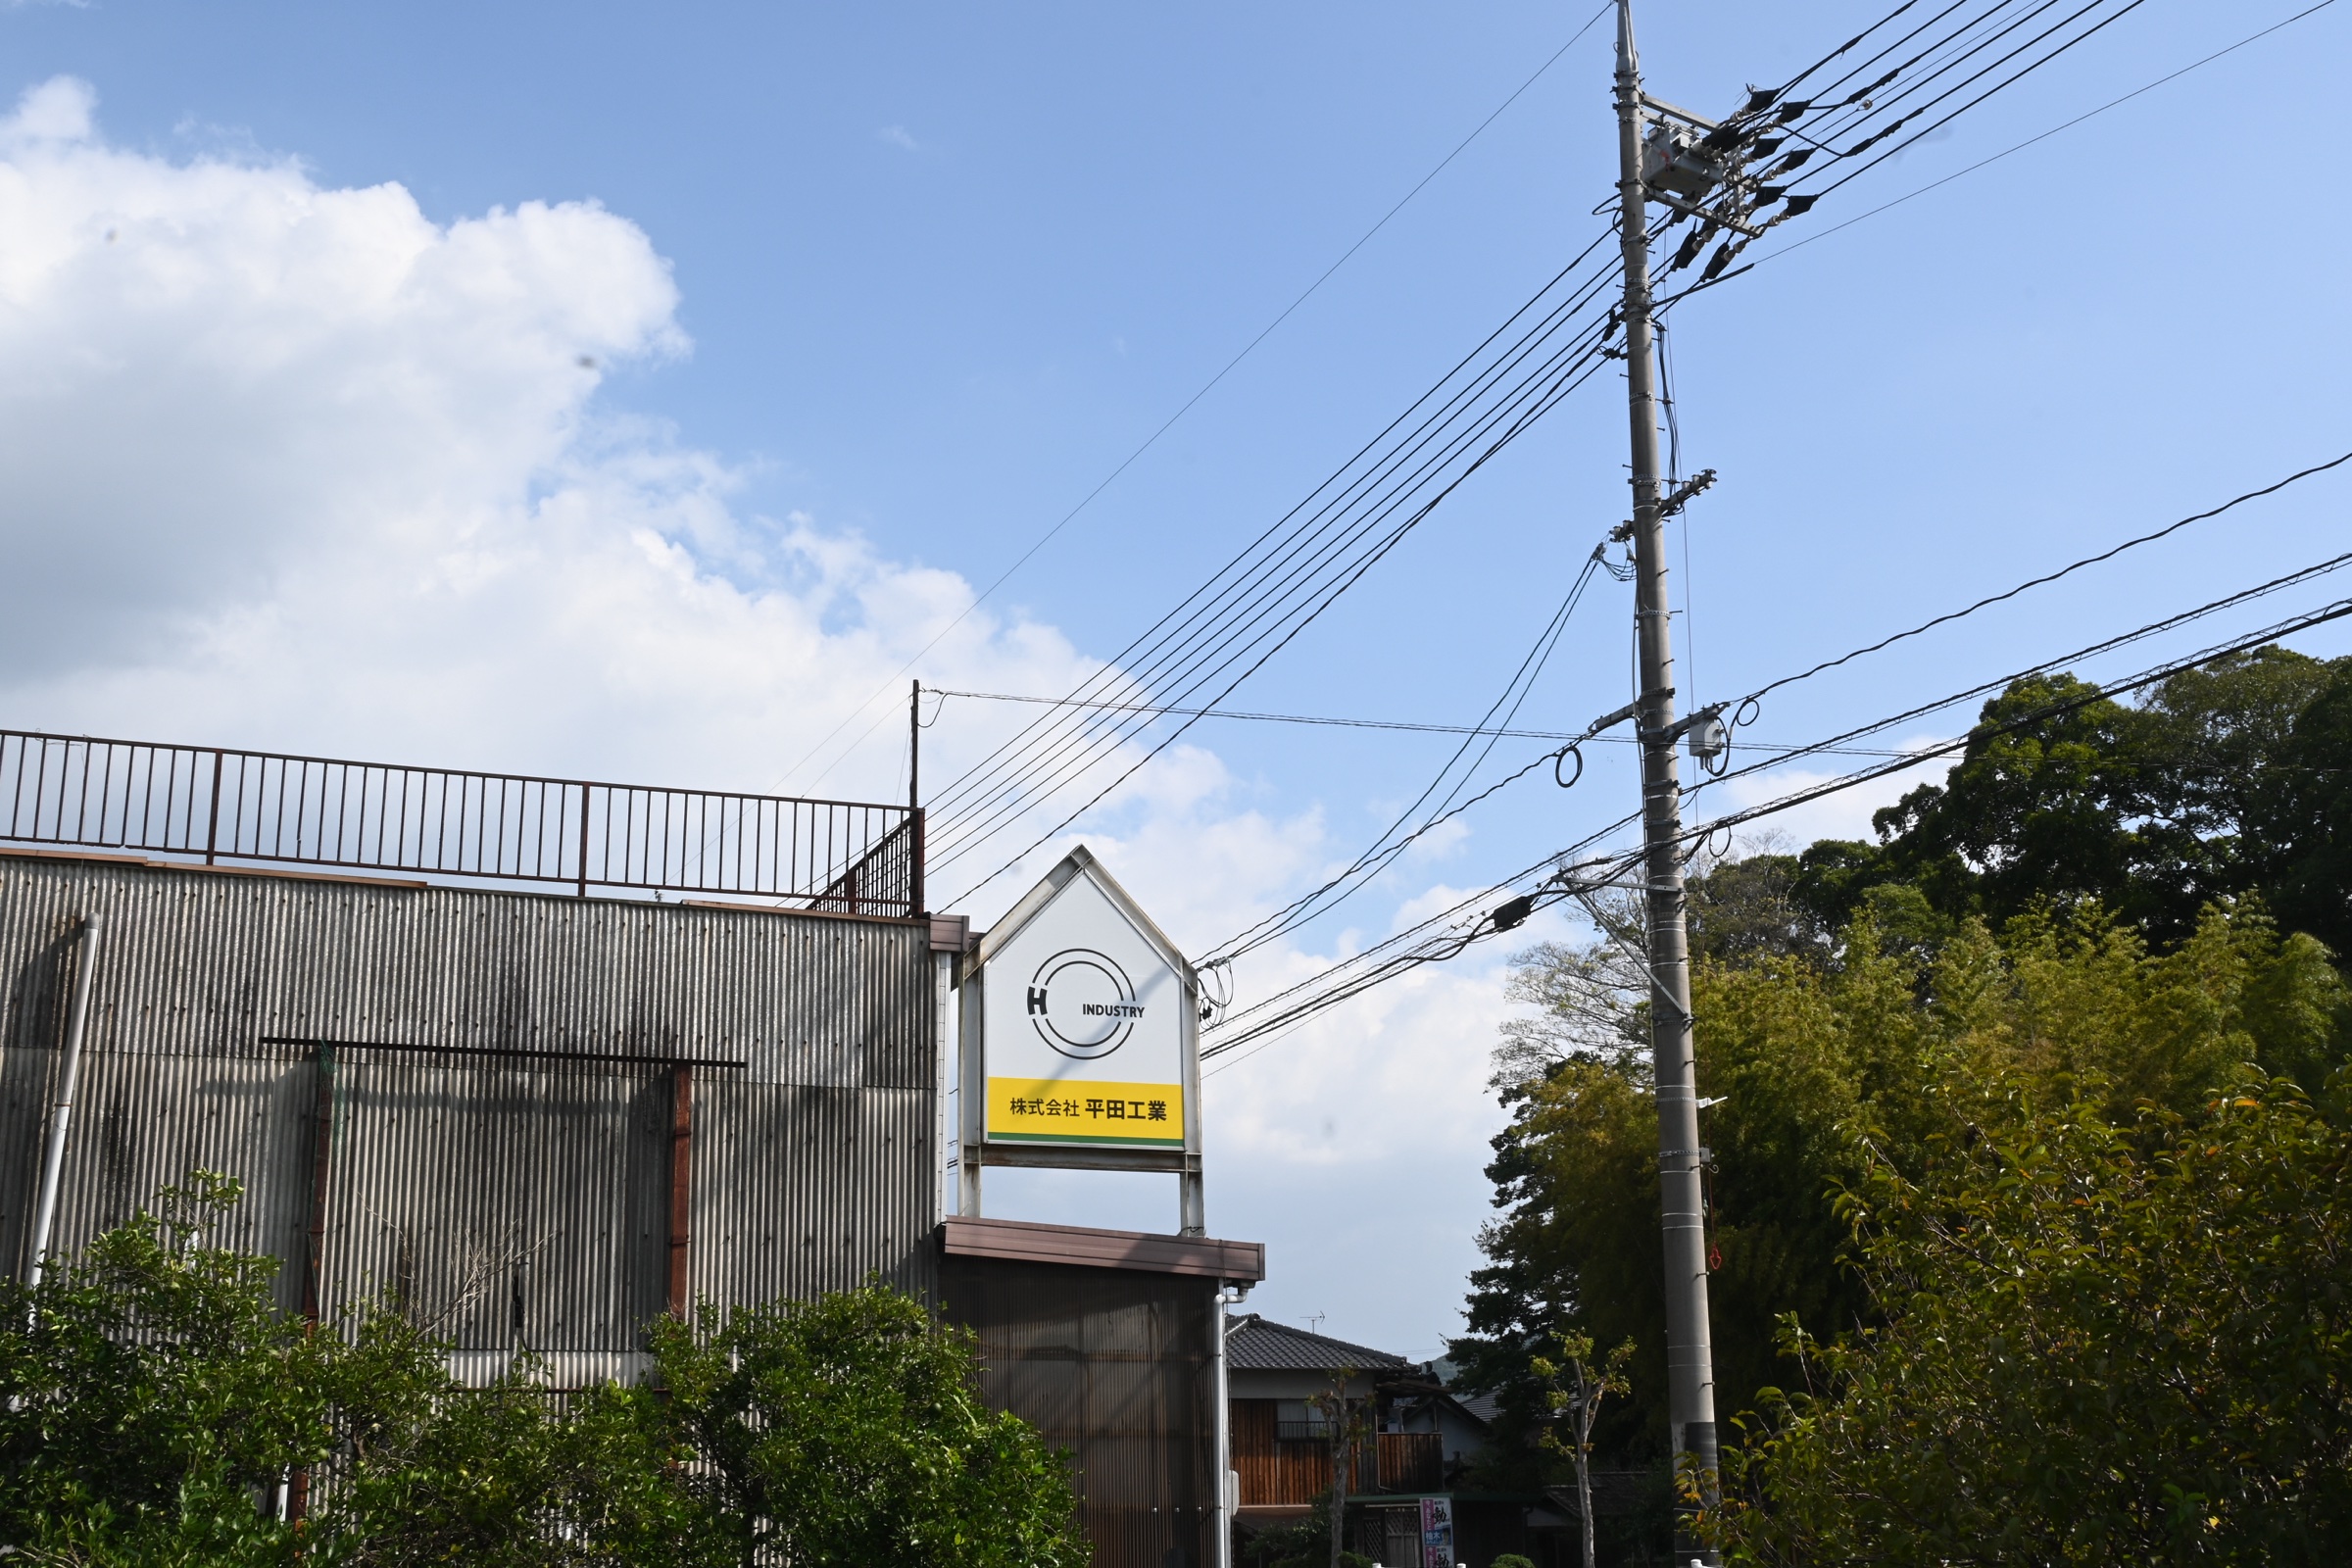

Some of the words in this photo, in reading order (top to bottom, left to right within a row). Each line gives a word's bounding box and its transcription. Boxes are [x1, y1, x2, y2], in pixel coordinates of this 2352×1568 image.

[1027, 986, 1048, 1015] H
[1082, 1004, 1145, 1018] INDUSTRY
[1009, 1098, 1080, 1117] 株式会社
[1085, 1099, 1167, 1121] 平田工業
